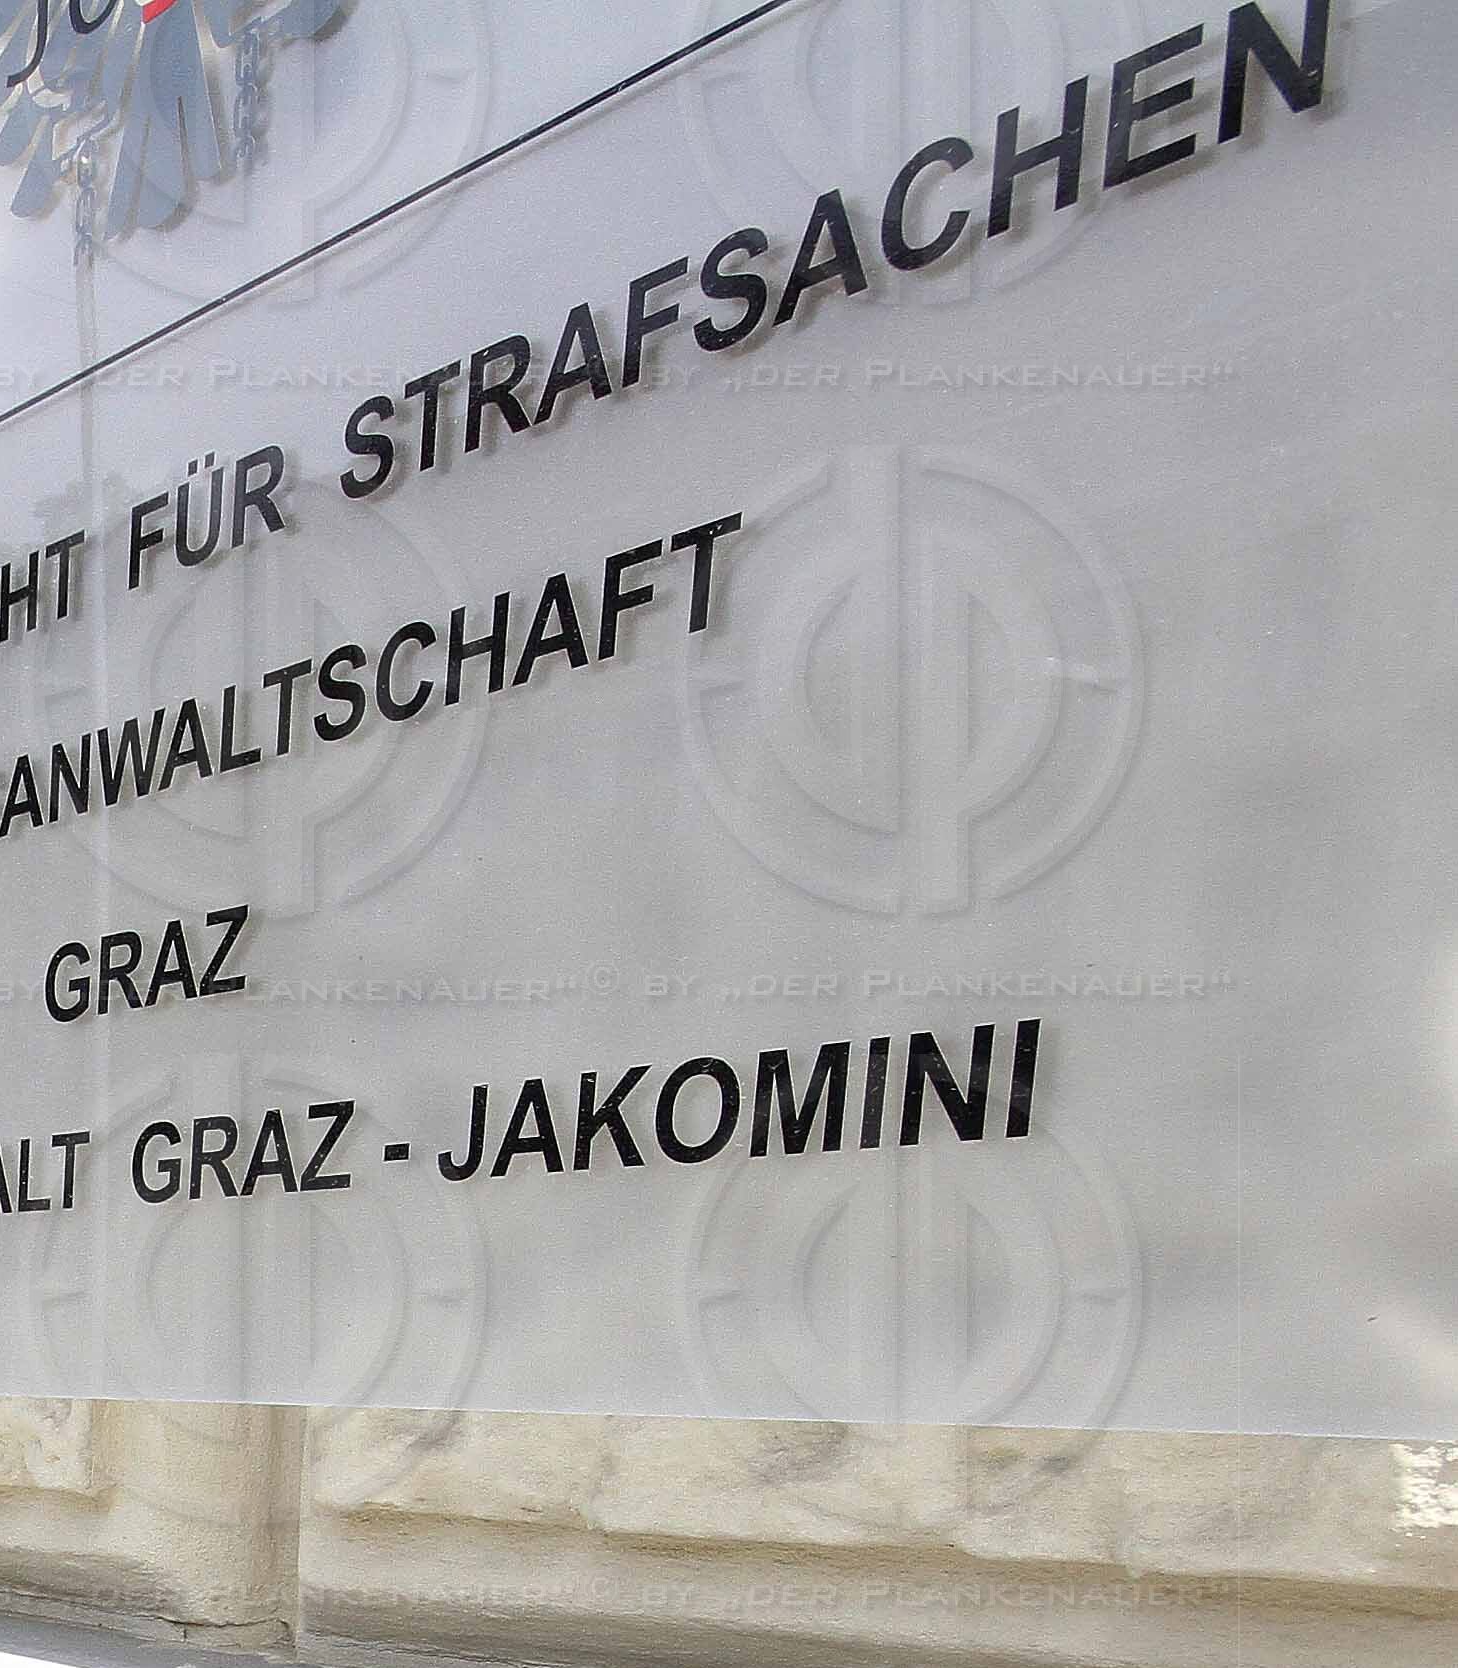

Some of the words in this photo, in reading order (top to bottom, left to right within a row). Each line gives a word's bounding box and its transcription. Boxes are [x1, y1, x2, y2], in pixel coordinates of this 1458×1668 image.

[127, 444, 287, 591] FÜR
[339, 0, 1331, 500] STRAFSACHEN
[44, 903, 250, 1024] GRAZ
[131, 1099, 356, 1205] GRAZ
[437, 1017, 1042, 1183] JAKOMINI
